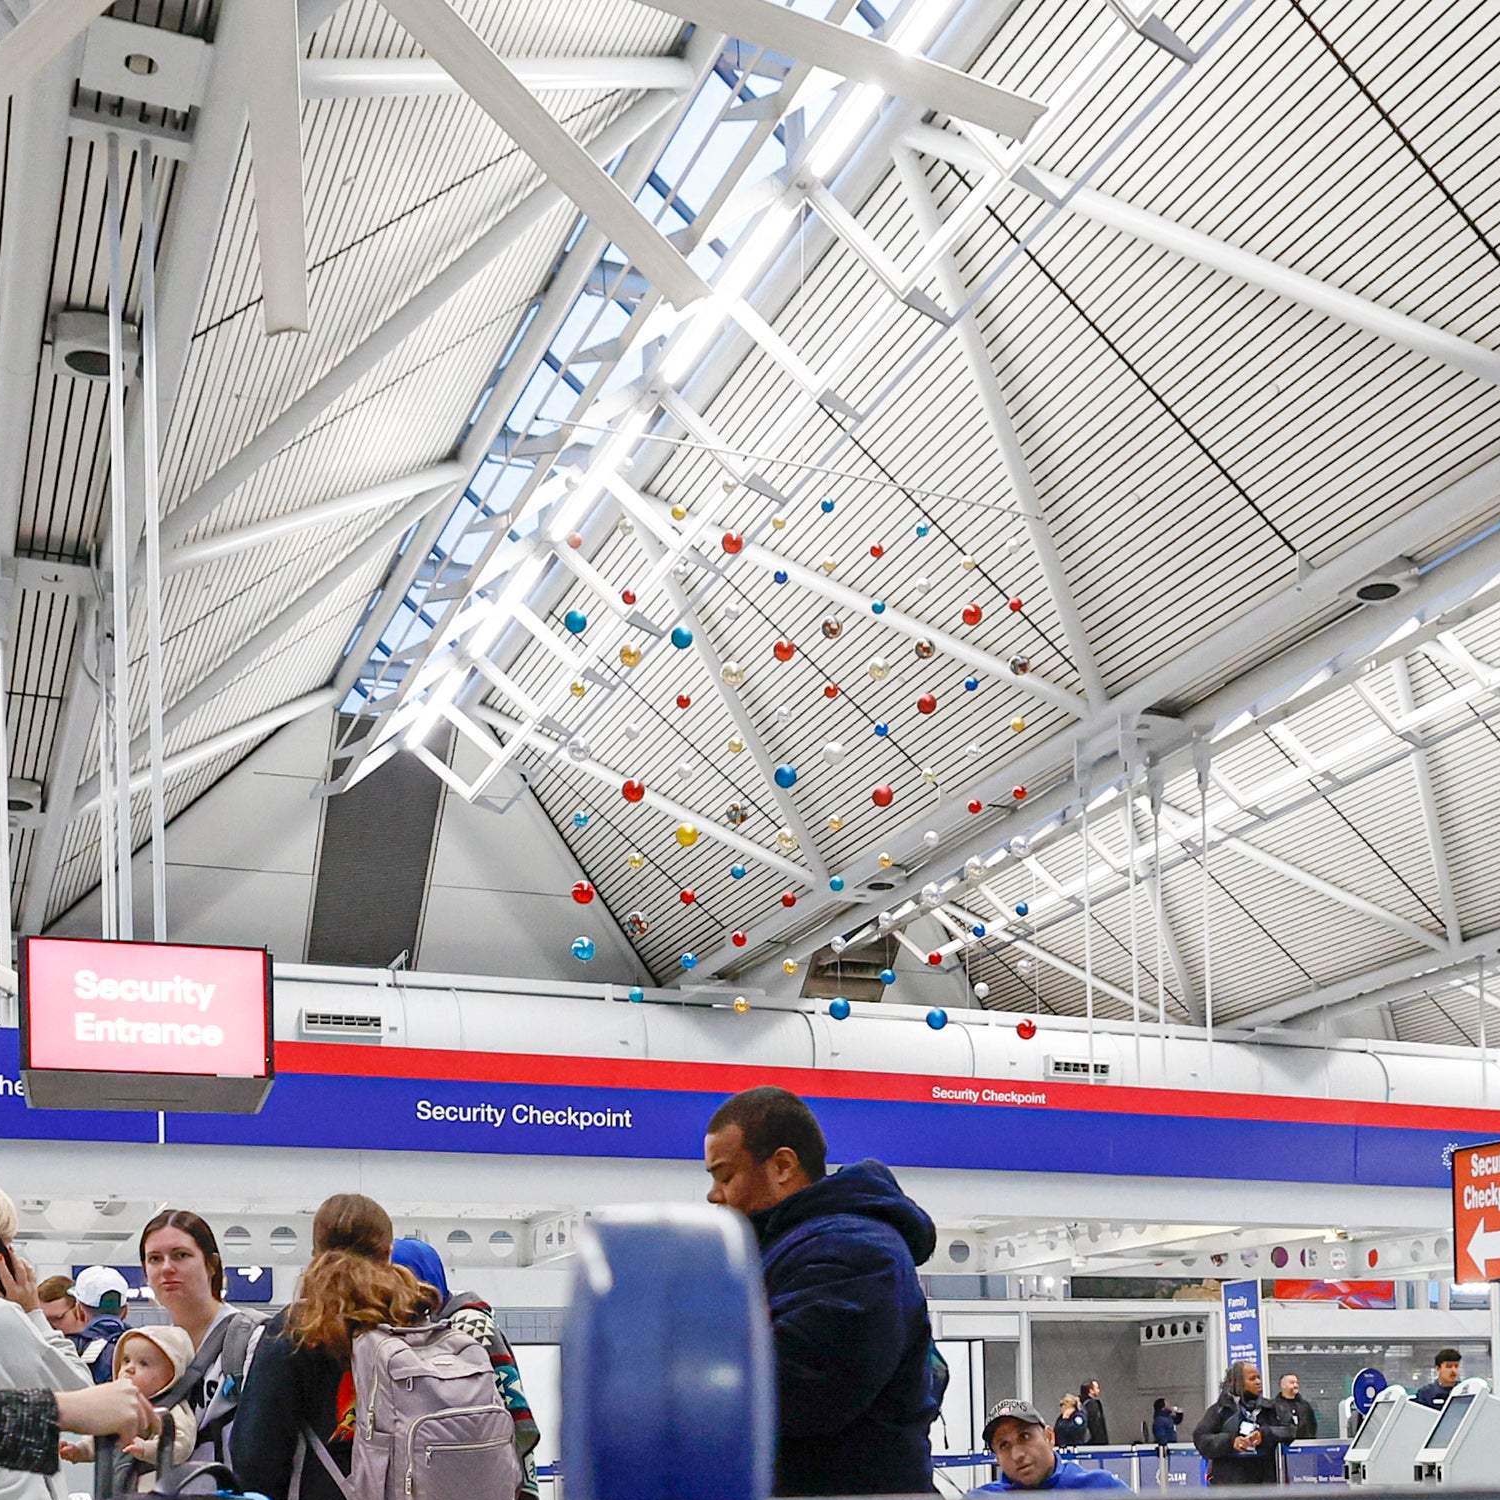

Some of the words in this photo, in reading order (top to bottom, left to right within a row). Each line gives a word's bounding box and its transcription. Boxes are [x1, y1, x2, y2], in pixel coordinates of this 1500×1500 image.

[74, 969, 216, 1011] Security
[74, 1012, 224, 1046] Entrance
[932, 1086, 979, 1103] Security
[982, 1089, 1046, 1105] Checkpoint
[416, 1100, 506, 1127] Security
[512, 1104, 633, 1130] Checkpoint
[1228, 1296, 1248, 1308] Family
